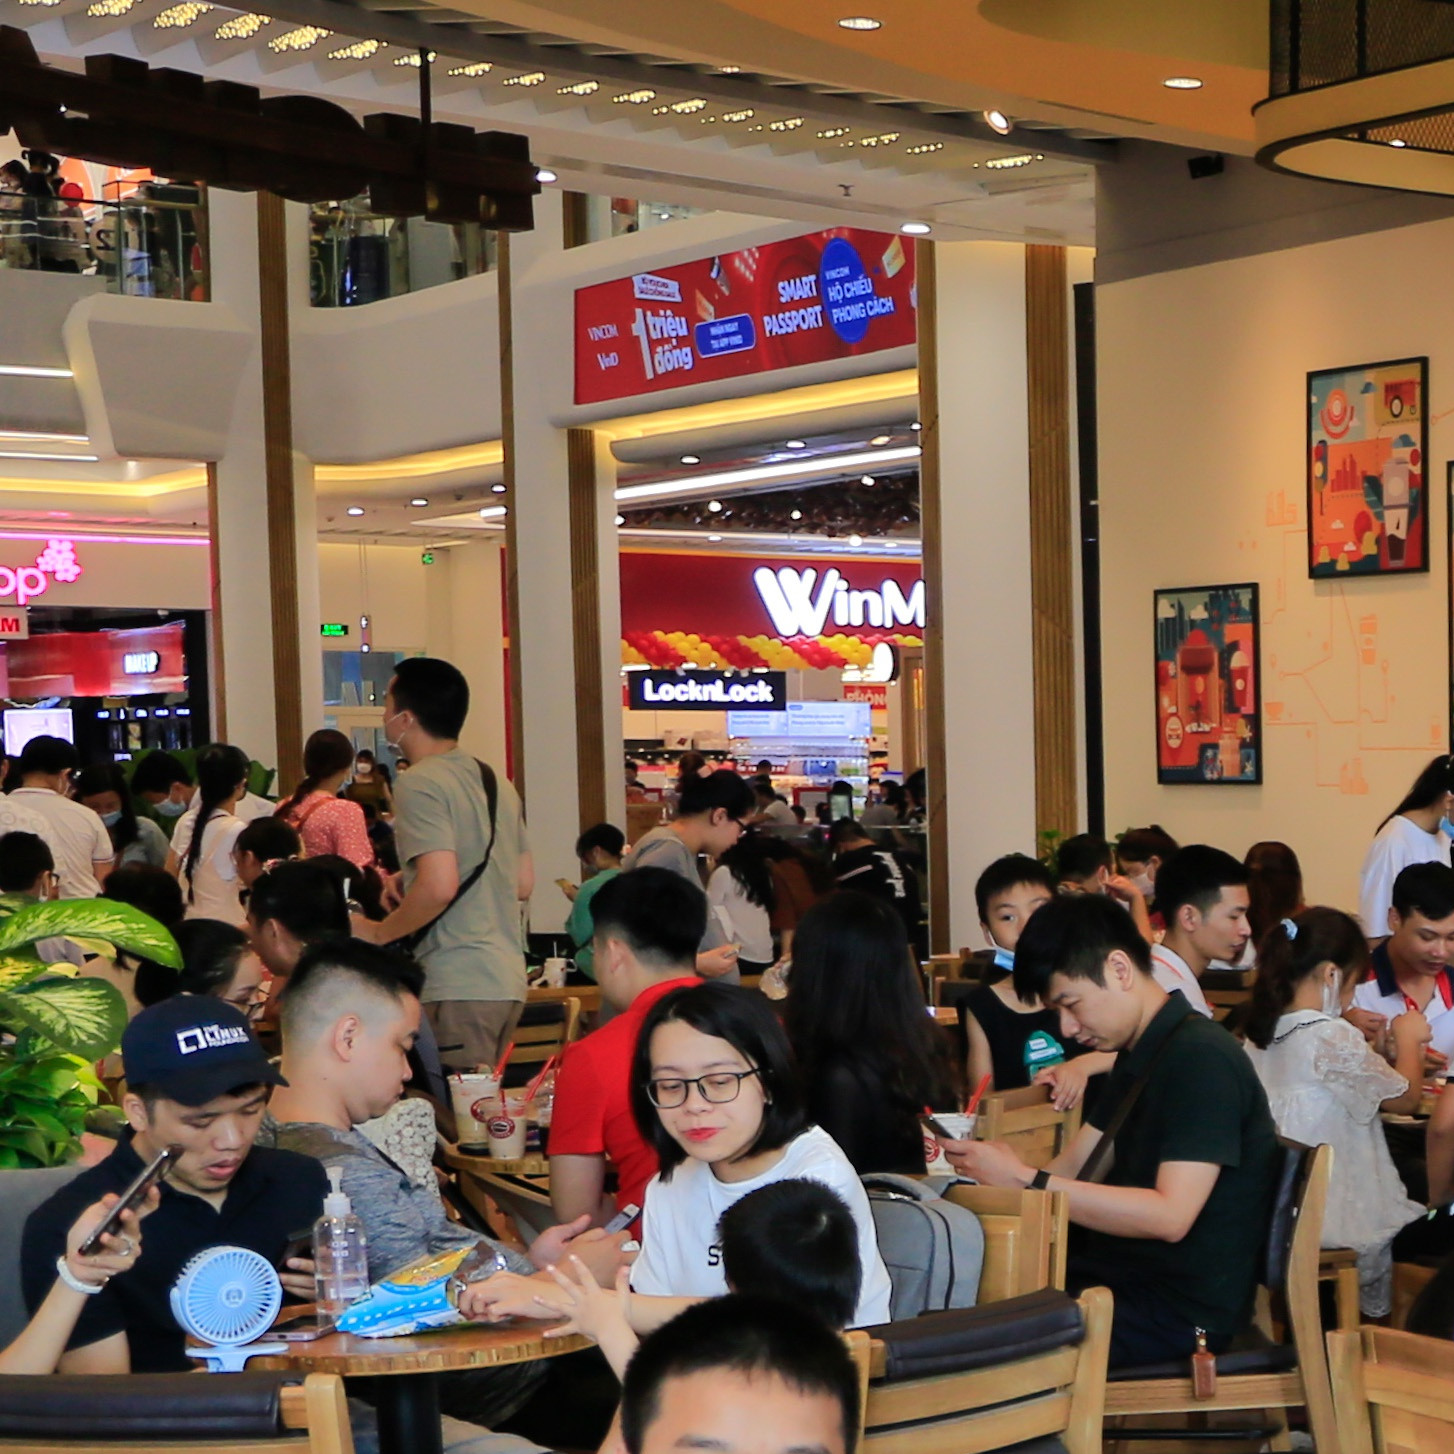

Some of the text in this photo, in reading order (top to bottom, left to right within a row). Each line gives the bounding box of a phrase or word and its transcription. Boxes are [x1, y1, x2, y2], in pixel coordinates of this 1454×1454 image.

[778, 275, 817, 303] SMART
[763, 305, 823, 338] PASSPORT
[831, 295, 895, 325] PHONG CÁCH
[587, 324, 619, 341] VINCOM
[630, 308, 654, 380] 1
[643, 679, 774, 703] LocknLock
